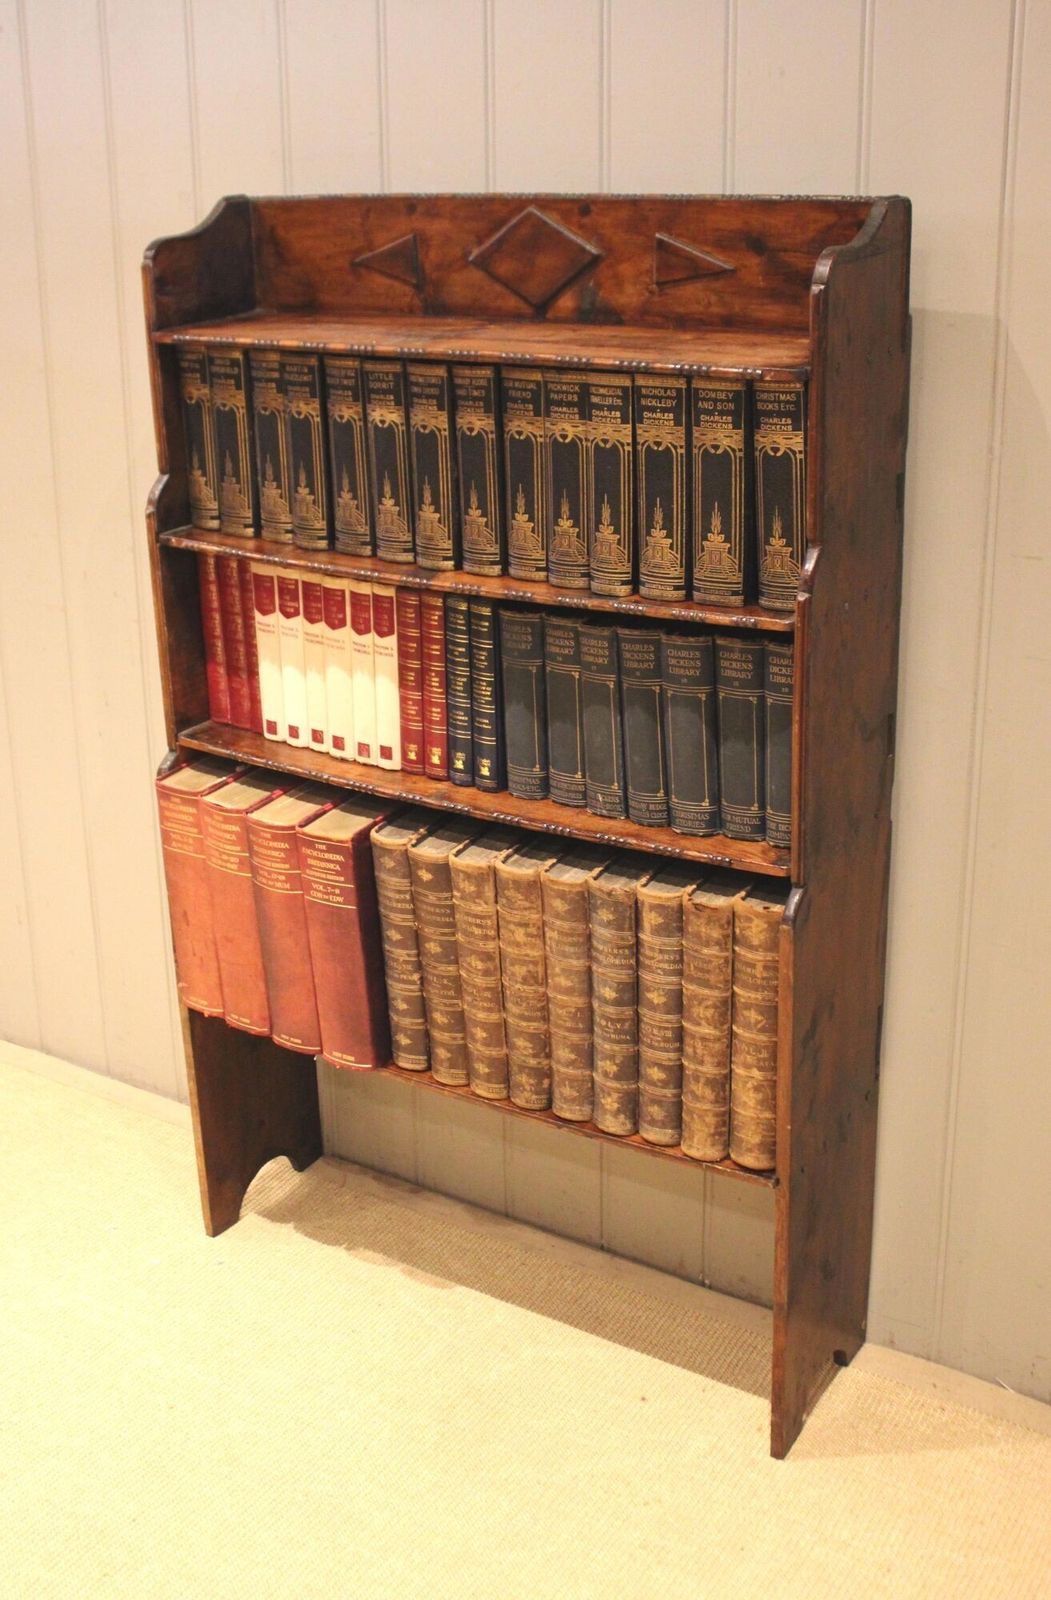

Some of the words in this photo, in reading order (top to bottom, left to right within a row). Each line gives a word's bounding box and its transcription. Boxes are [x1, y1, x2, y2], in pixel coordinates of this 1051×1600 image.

[368, 372, 394, 381] LITTLE
[368, 381, 394, 390] DORRIT
[547, 382, 580, 393] PICKWICK
[508, 389, 532, 399] FRIEND
[550, 392, 578, 402] PAPERS
[641, 388, 677, 397] NICHOLAS
[698, 389, 734, 400] DOMBEY
[755, 391, 797, 401] CHRISTMAS
[640, 397, 677, 407] NICKLEBY
[698, 400, 714, 410] AND
[716, 401, 735, 410] SON
[756, 402, 779, 411] BOOKS
[550, 405, 578, 413] CHARLES
[592, 409, 621, 418] CHARLES
[550, 412, 579, 420] DICKENS
[592, 416, 621, 424] DICKENS
[643, 411, 674, 420] CHARLES
[700, 414, 732, 423] CHARLES
[760, 416, 792, 425] CHARLES
[643, 419, 675, 427] DICKENS
[700, 421, 733, 429] DICKENS
[760, 423, 793, 431] DICKENS
[667, 649, 700, 659] CHARLES
[719, 650, 752, 661] CHARLES
[668, 658, 701, 668] DICKENS
[720, 660, 753, 670] DICKENS
[769, 656, 793, 665] CHARL
[669, 666, 701, 677] LIBRARY
[721, 668, 753, 680] LIBRARY
[770, 666, 793, 676] DICKE
[770, 674, 794, 684] LIBRA
[673, 810, 710, 820] CHRISTMAS
[733, 814, 762, 825] MUTUAL
[726, 823, 752, 833] FRIEND
[315, 843, 327, 851] THE
[311, 882, 326, 892] VOL.
